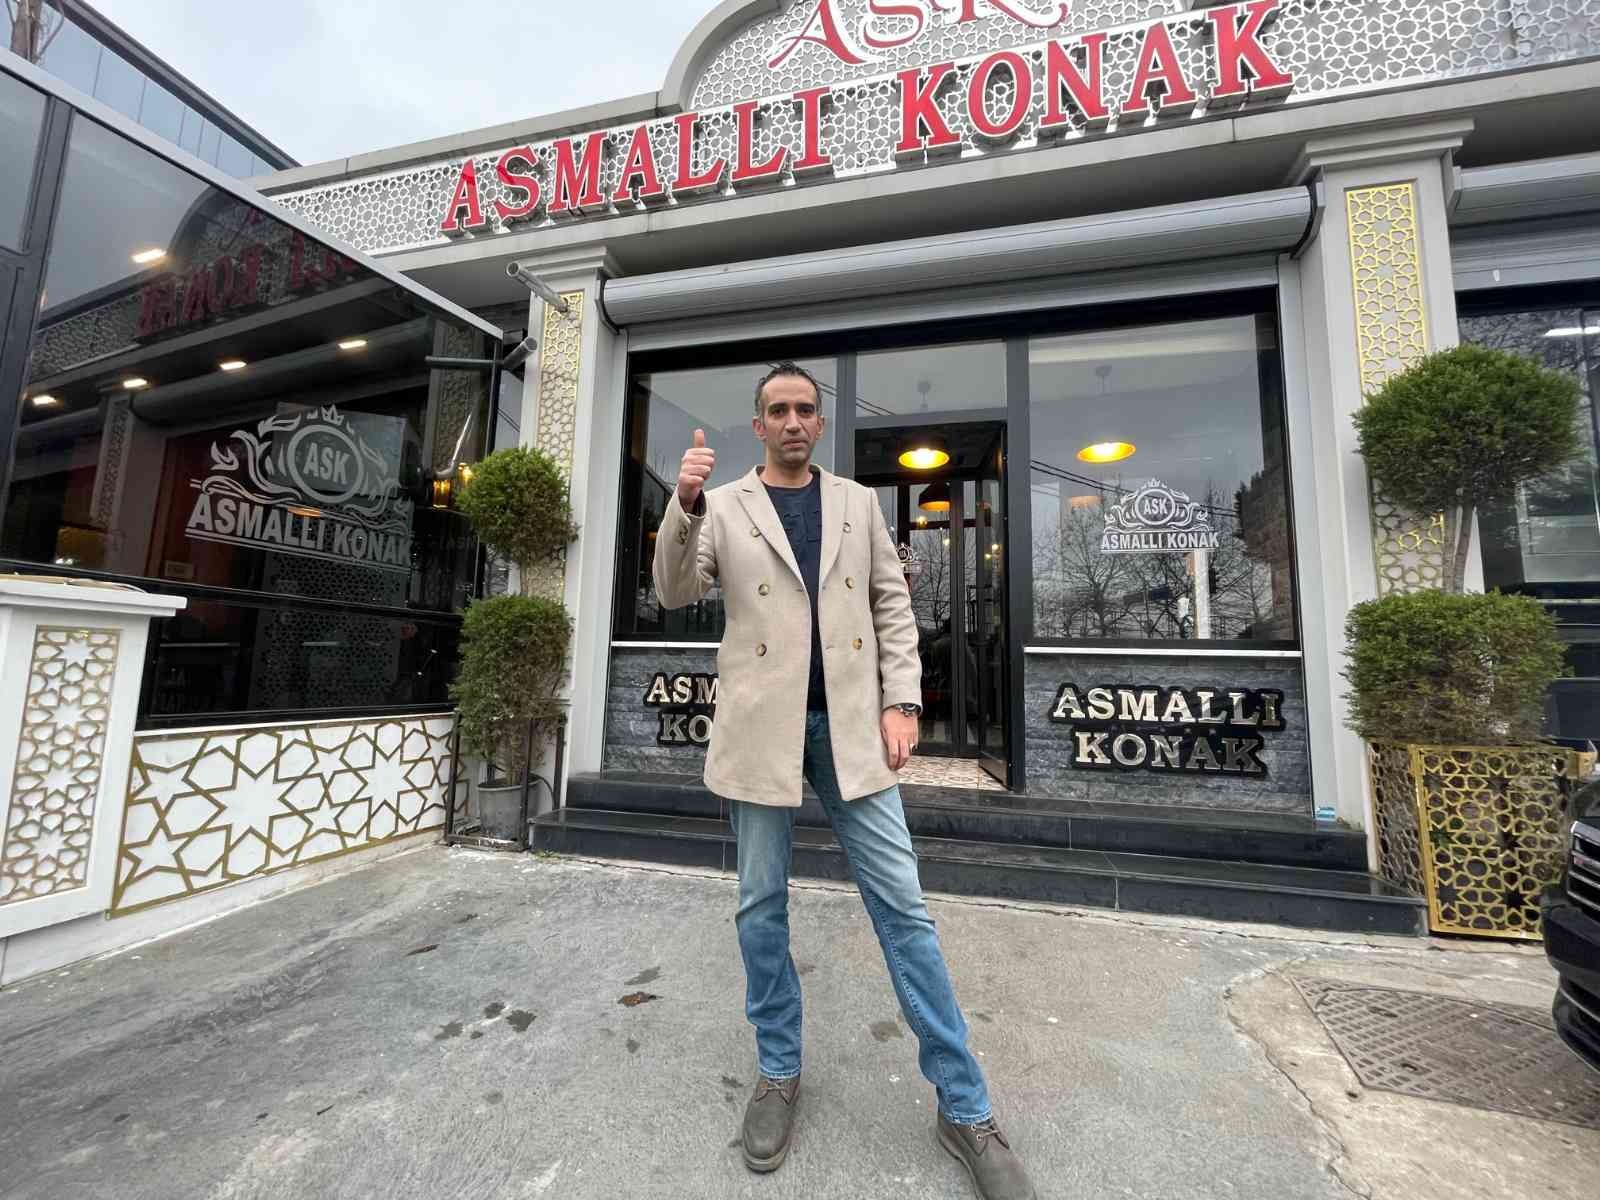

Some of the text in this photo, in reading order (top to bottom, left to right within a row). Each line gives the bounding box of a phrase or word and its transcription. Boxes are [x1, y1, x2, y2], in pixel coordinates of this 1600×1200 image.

[440, 0, 1294, 231] ASMALLI KONAK
[303, 442, 351, 485] ASK
[1143, 498, 1168, 515] ASK
[186, 493, 324, 551] ASMALLI
[332, 523, 412, 567] KONAK
[1101, 531, 1219, 550] ASMALLI KONAK
[1052, 687, 1280, 727] ASMALLI
[1074, 731, 1263, 773] KONAK
